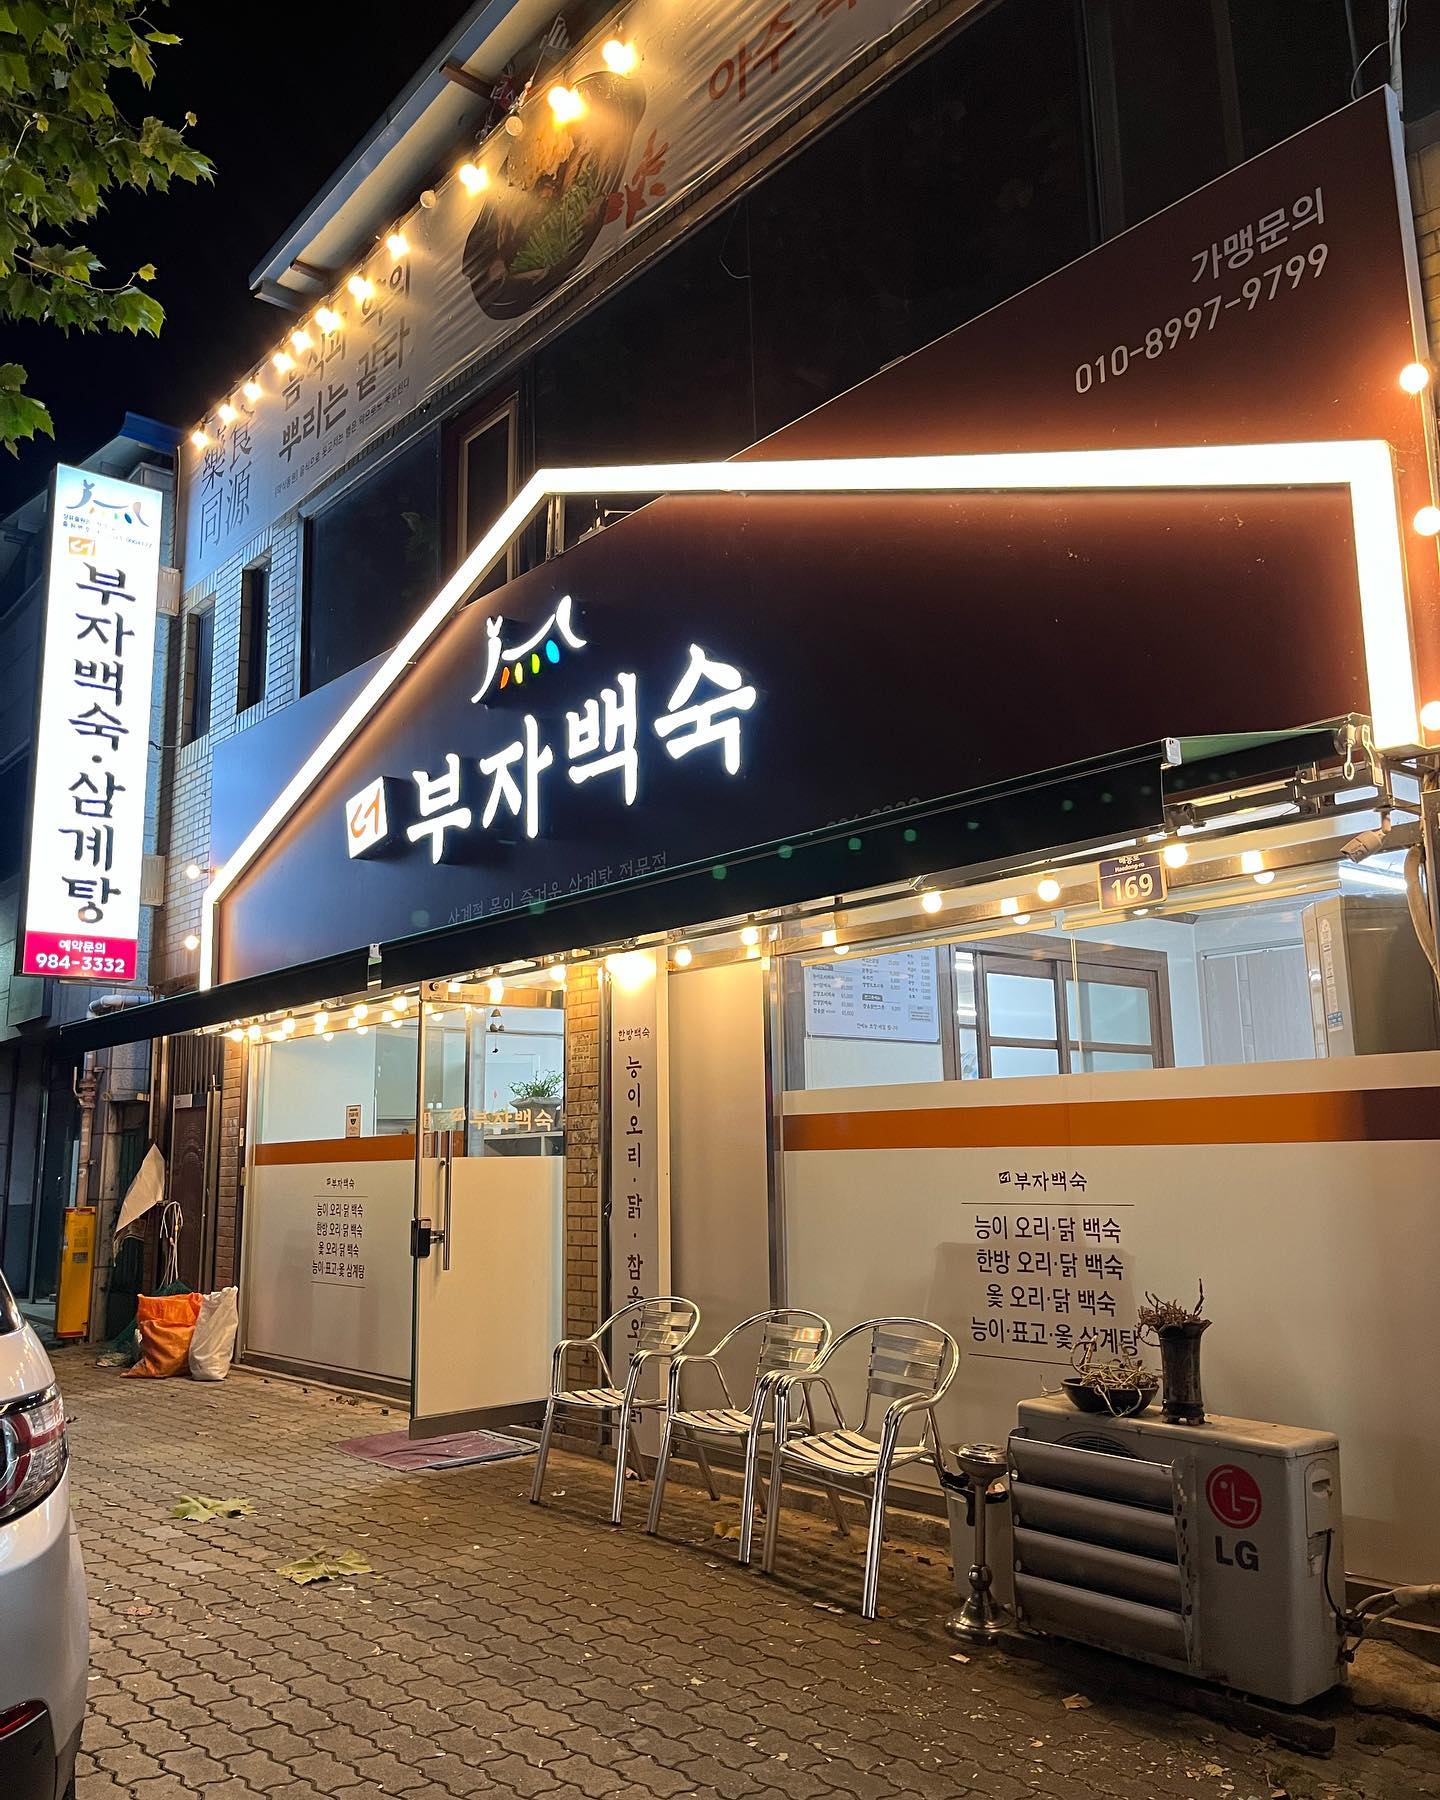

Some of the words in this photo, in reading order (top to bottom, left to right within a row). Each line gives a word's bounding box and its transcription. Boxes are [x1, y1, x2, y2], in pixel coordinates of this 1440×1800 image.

[709, 2, 796, 102] 아주
[1191, 186, 1324, 283] 가맹문의
[1075, 243, 1328, 393] 010-8997-9799
[279, 383, 348, 463] 뿌리는
[355, 317, 411, 401] 같다
[58, 562, 136, 924] 부자백숙·삼계탕
[406, 643, 757, 865] 부자백숙
[1111, 873, 1153, 901] 169
[59, 939, 106, 954] 예약문의
[35, 952, 126, 973] 984-3332
[617, 1027, 650, 1041] 한방백숙
[331, 1178, 355, 1190] 부자백숙
[1014, 1170, 1088, 1192] 부자백숙
[317, 1203, 328, 1217] 능이
[351, 1203, 363, 1218] 백숙
[317, 1222, 328, 1236] 한방
[351, 1223, 363, 1238] 백숙
[975, 1215, 1008, 1240] 능이
[1015, 1216, 1076, 1243] 오리·닭
[1083, 1217, 1121, 1243] 백숙
[347, 1243, 360, 1258] 백숙
[976, 1248, 1010, 1275] 한방
[1016, 1251, 1078, 1278] 오리·닭
[1085, 1254, 1123, 1280] 백숙
[346, 1263, 365, 1280] 삼계탕
[986, 1283, 1004, 1309] 옻
[1010, 1285, 1071, 1314] 오리·닭
[1078, 1289, 1116, 1317] 백숙
[970, 1316, 1073, 1350] 능이·표고·옻
[1079, 1325, 1139, 1357] 삼계탕
[1215, 1535, 1259, 1571] LG
